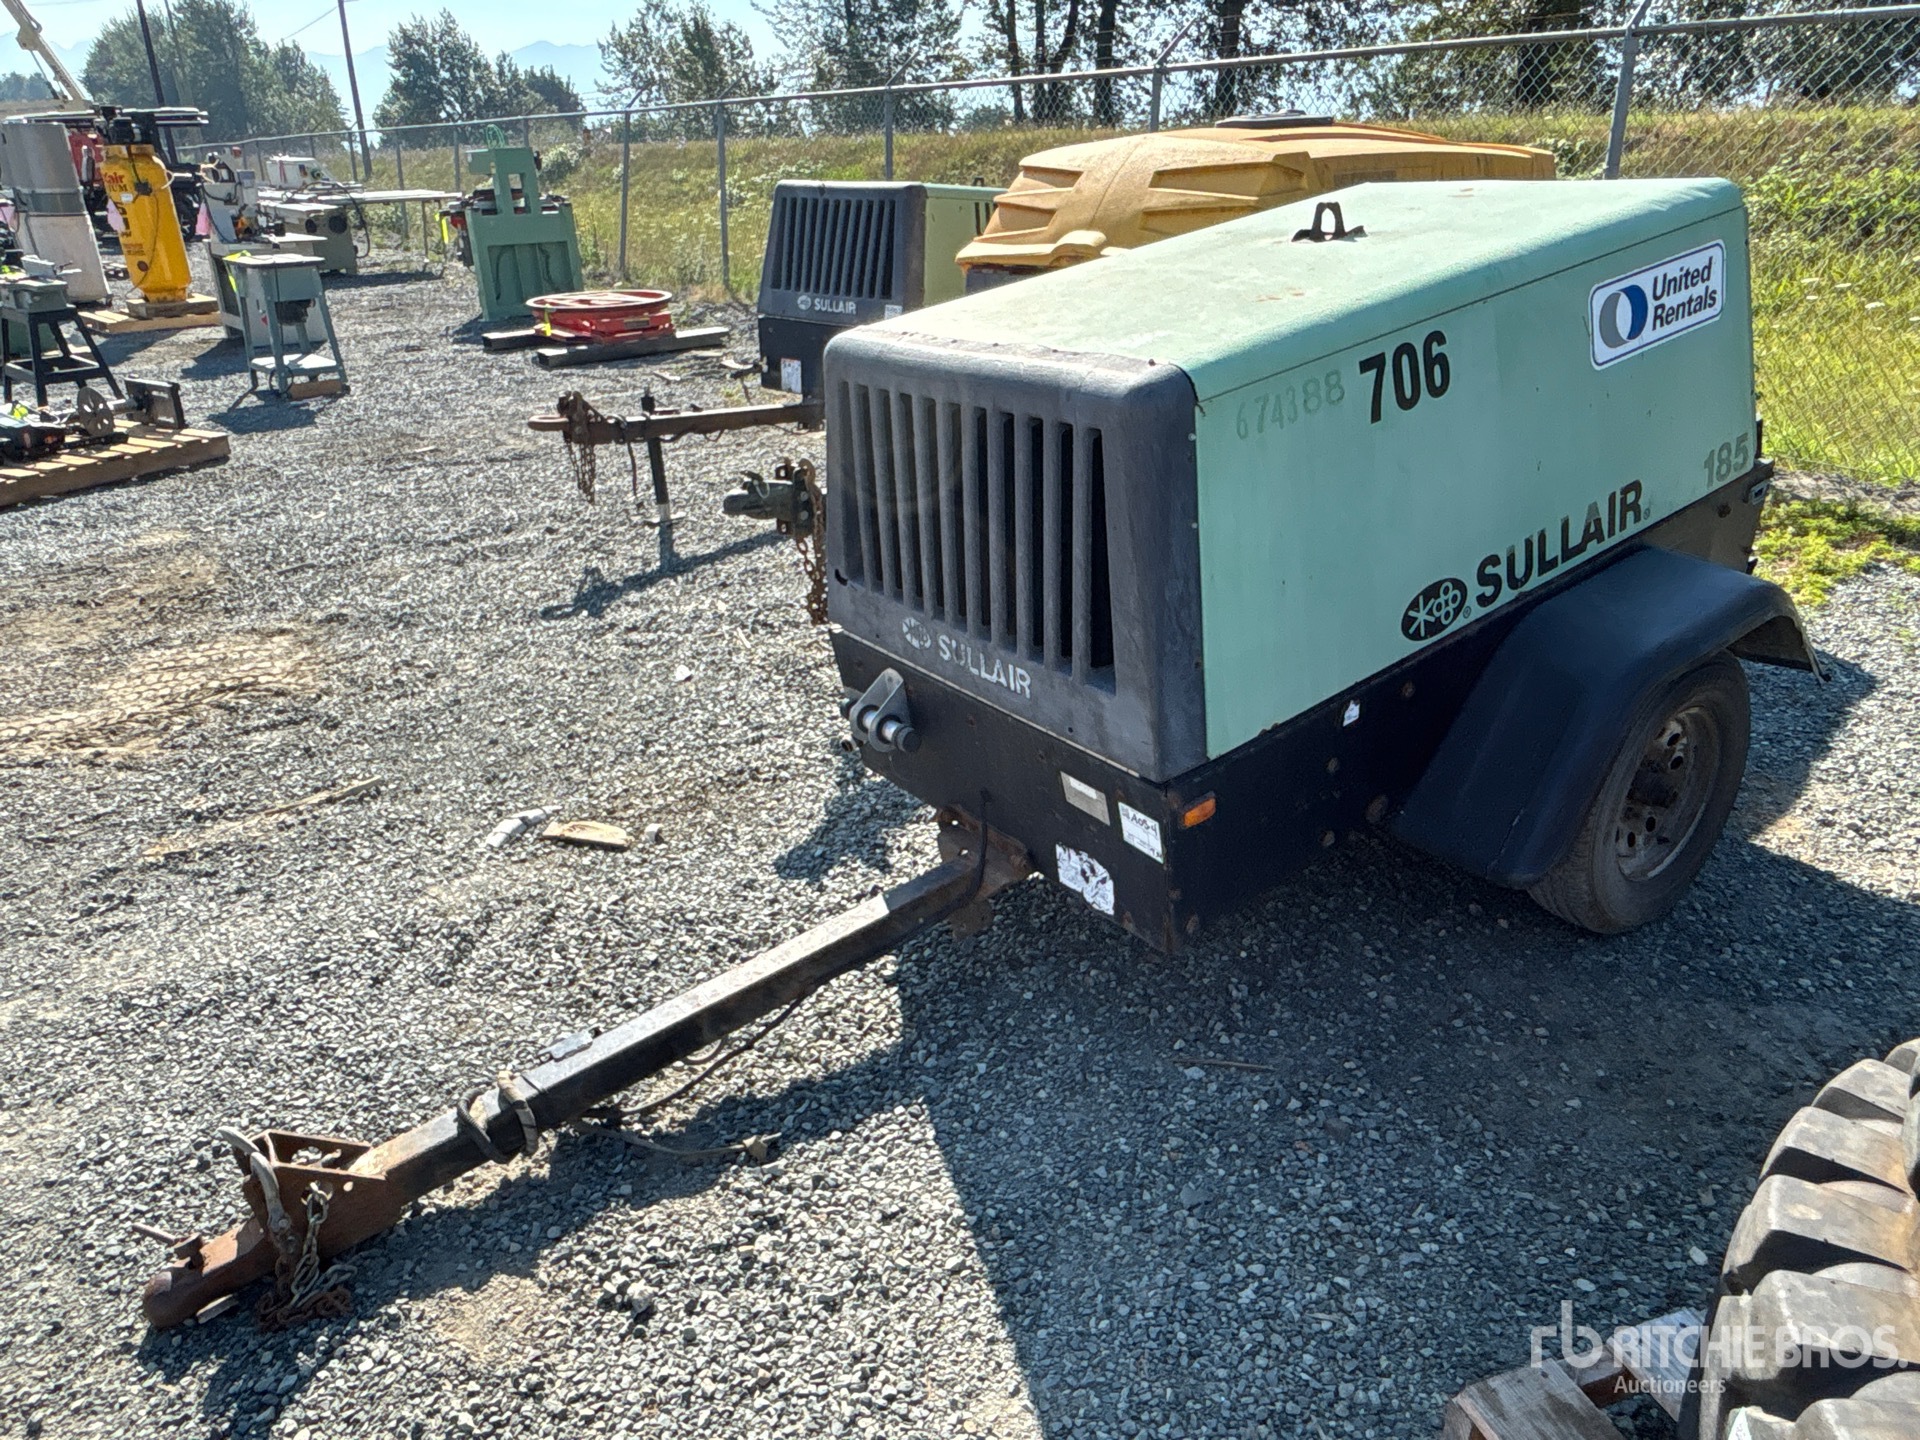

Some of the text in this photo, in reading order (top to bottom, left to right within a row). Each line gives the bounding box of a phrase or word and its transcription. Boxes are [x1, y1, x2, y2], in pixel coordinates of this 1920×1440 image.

[814, 298, 857, 315] SULLAIR
[1652, 256, 1713, 301] United
[1652, 285, 1717, 331] Rentals
[1236, 369, 1345, 439] 674388
[1359, 330, 1450, 424] 706
[1703, 432, 1749, 490] 185
[1476, 480, 1644, 608] SULLAIR
[938, 634, 1031, 699] SULLAIR
